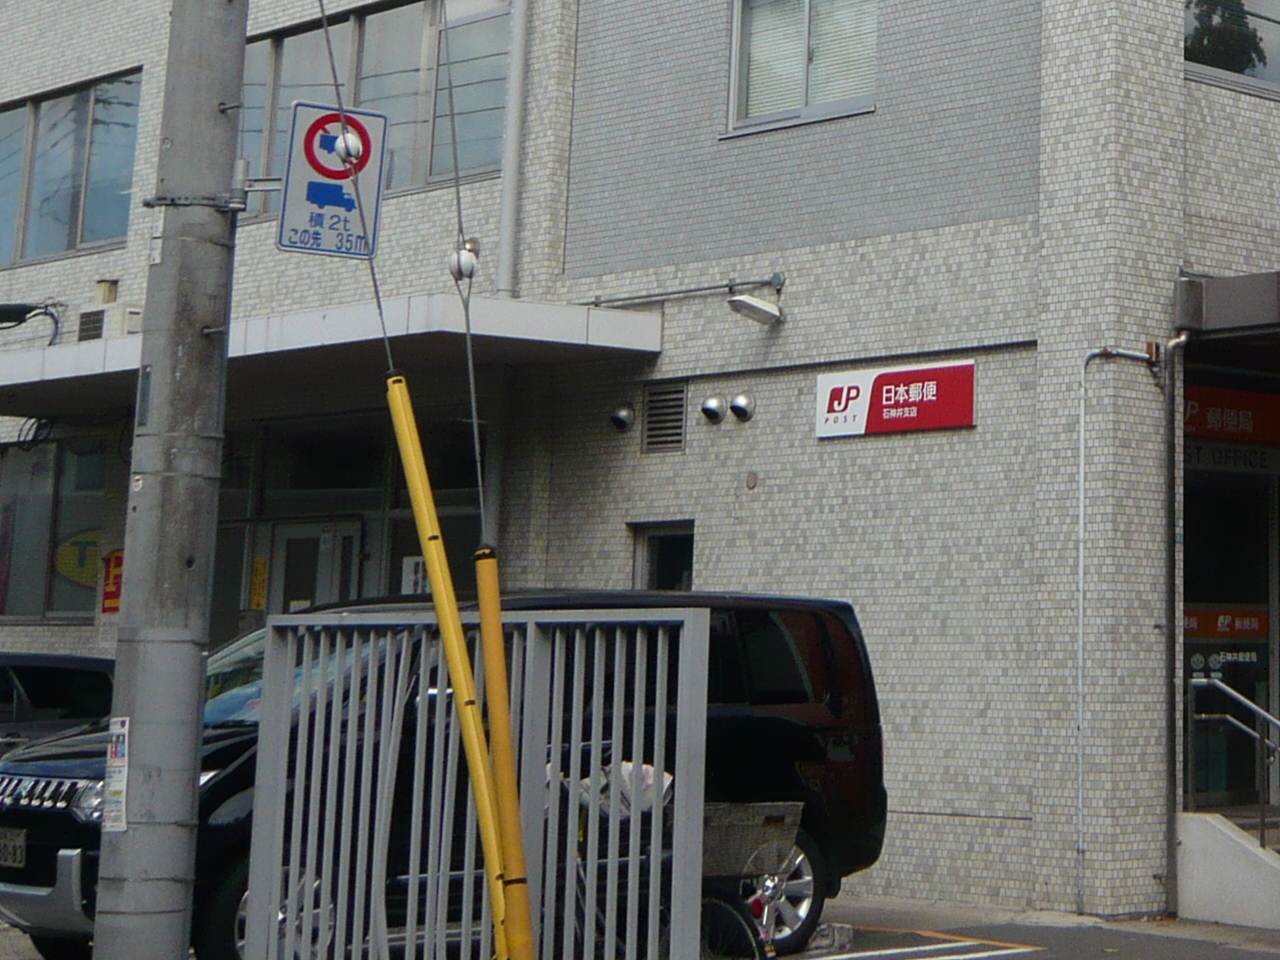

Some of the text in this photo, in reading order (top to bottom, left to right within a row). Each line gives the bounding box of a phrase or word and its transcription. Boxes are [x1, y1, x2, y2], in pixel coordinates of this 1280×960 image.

[328, 214, 351, 232] 2t
[288, 228, 369, 253] この先 35m
[826, 384, 861, 414] JP
[882, 380, 937, 406] 日本郵便
[824, 414, 858, 425] POST
